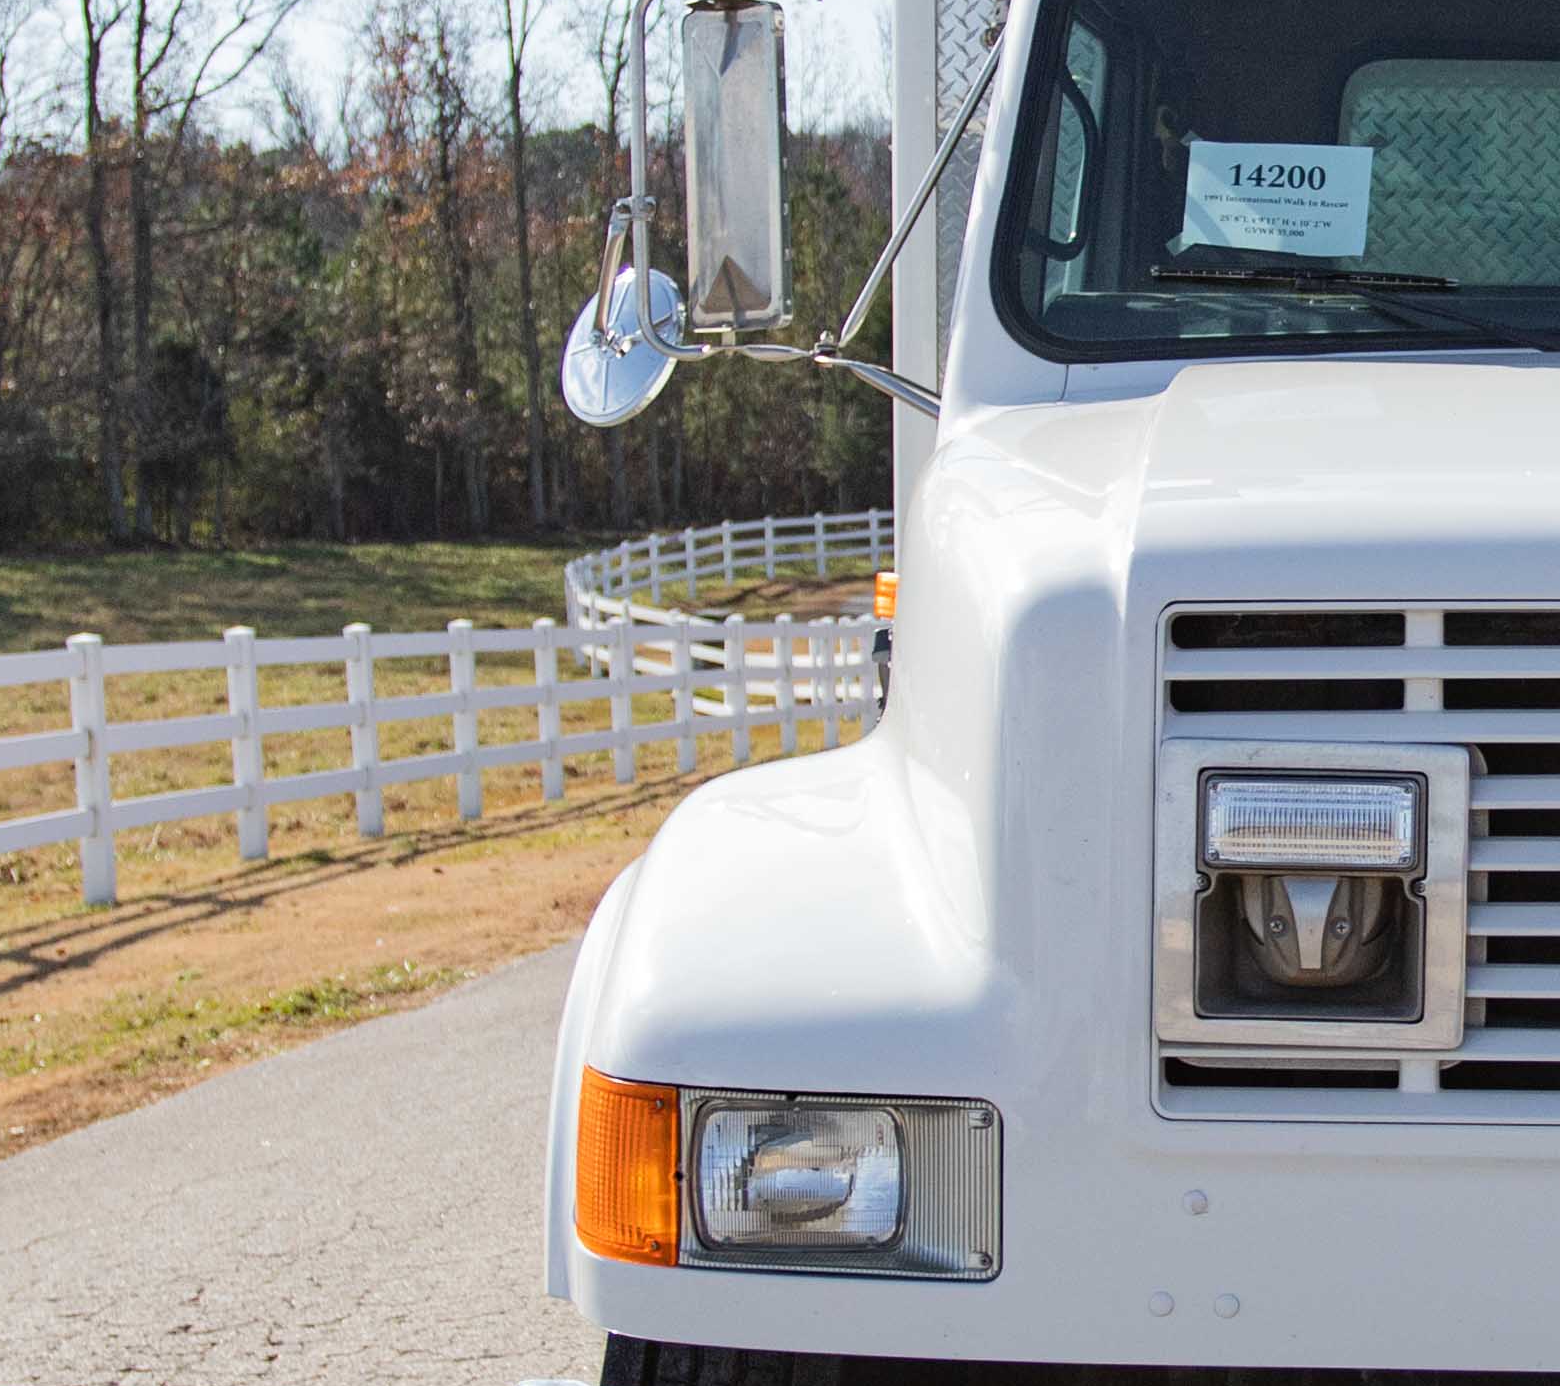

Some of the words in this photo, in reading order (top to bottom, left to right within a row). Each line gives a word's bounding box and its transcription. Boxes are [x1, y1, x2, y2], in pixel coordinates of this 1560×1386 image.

[1229, 163, 1327, 190] 14200
[1225, 195, 1281, 204] International
[1320, 199, 1349, 208] Rescue
